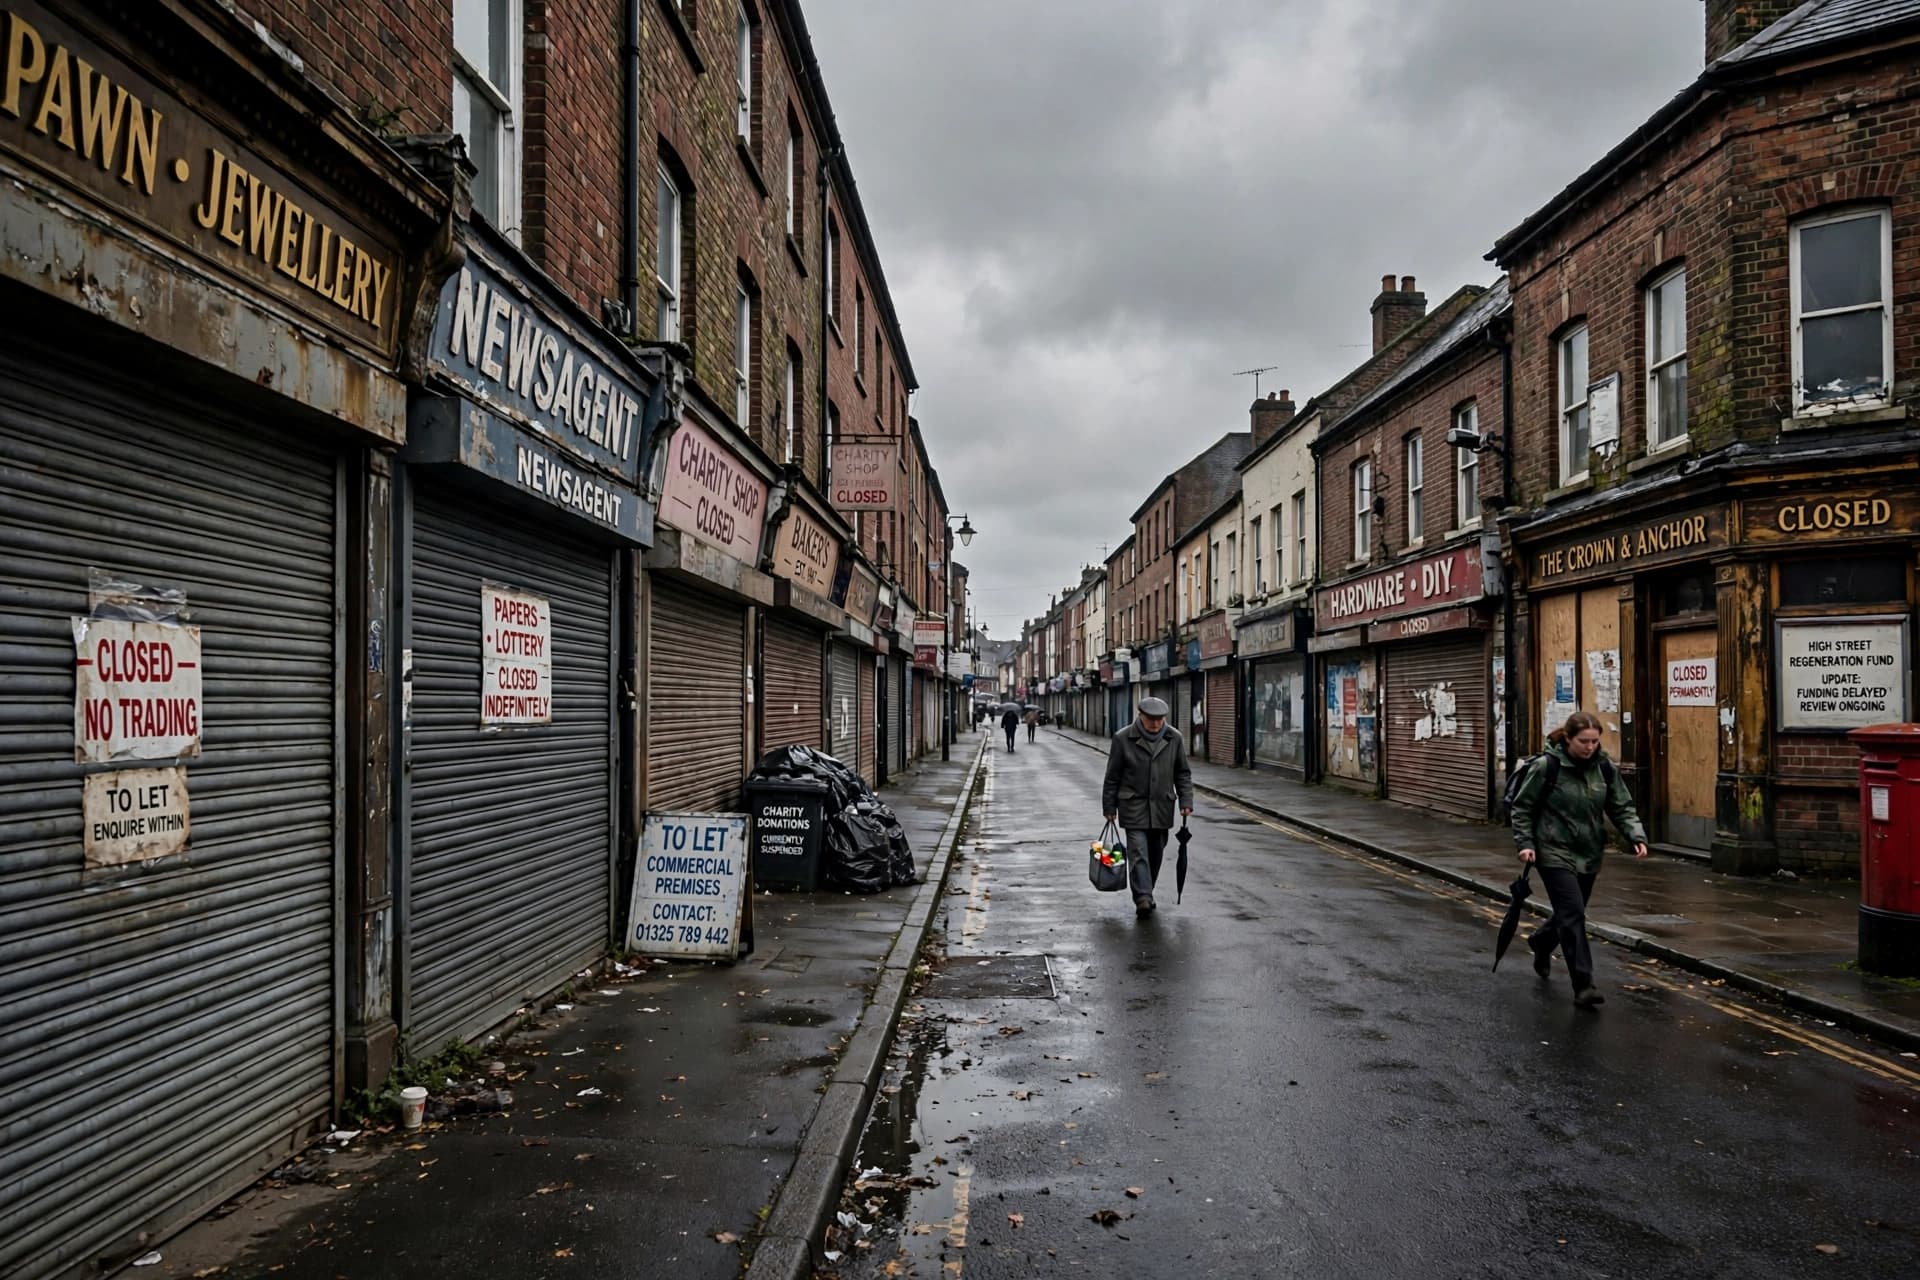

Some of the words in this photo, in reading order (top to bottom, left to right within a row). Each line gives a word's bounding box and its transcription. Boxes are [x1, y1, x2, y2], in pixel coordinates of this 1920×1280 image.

[0, 11, 162, 196] PAWN
[197, 149, 391, 329] JEWELLERY
[451, 266, 639, 461] NEWSAGENT
[836, 449, 889, 461] CHARITY
[679, 431, 733, 501] CHARITY
[732, 474, 759, 519] SHOP
[846, 463, 879, 474] SHOP
[517, 446, 622, 527] NEWSAGENT
[837, 490, 888, 504] CLOSED
[696, 496, 735, 546] CLOSED
[1778, 499, 1891, 532] CLOSED
[791, 515, 830, 569] BAKER'S
[1539, 551, 1564, 577] THE
[1567, 537, 1616, 571] CROWN
[1620, 534, 1632, 559] &
[1636, 515, 1707, 556] ANCHOR
[1331, 572, 1405, 618] HARDWARE
[1422, 557, 1455, 598] DIY
[494, 597, 538, 628] PAPERS
[496, 629, 544, 658] LOTTERY
[1808, 641, 1832, 652] HIGH
[1835, 640, 1872, 651] STREET
[97, 638, 173, 684] CLOSED
[1673, 665, 1707, 681] CLOSED
[1789, 656, 1863, 667] REGENERATION
[1866, 655, 1894, 666] FUND
[498, 666, 538, 691] CLOSED
[1822, 674, 1862, 685] UPDATE:
[1797, 687, 1839, 699] FUNDING
[1842, 687, 1887, 698] DELAYED
[484, 695, 549, 718] INDEFINITELY
[1800, 701, 1836, 712] REVIEW
[1838, 701, 1886, 712] ONGOING
[85, 698, 113, 742] NO
[119, 696, 198, 738] TRADING
[107, 788, 132, 813] TO
[138, 785, 169, 810] LET
[762, 806, 804, 817] CHARITY
[94, 820, 145, 841] ENQUIRE
[149, 814, 184, 835] WITHIN
[757, 818, 810, 830] DONATIONS
[662, 825, 687, 850] TO
[692, 826, 729, 852] LET
[761, 835, 805, 845] CUENTLY
[647, 855, 734, 875] COMMERCIAL
[655, 877, 721, 896] PREMISES
[652, 903, 717, 922] CONTACT:
[636, 923, 674, 942] 01325
[678, 925, 702, 944] 789
[705, 927, 729, 945] 442
